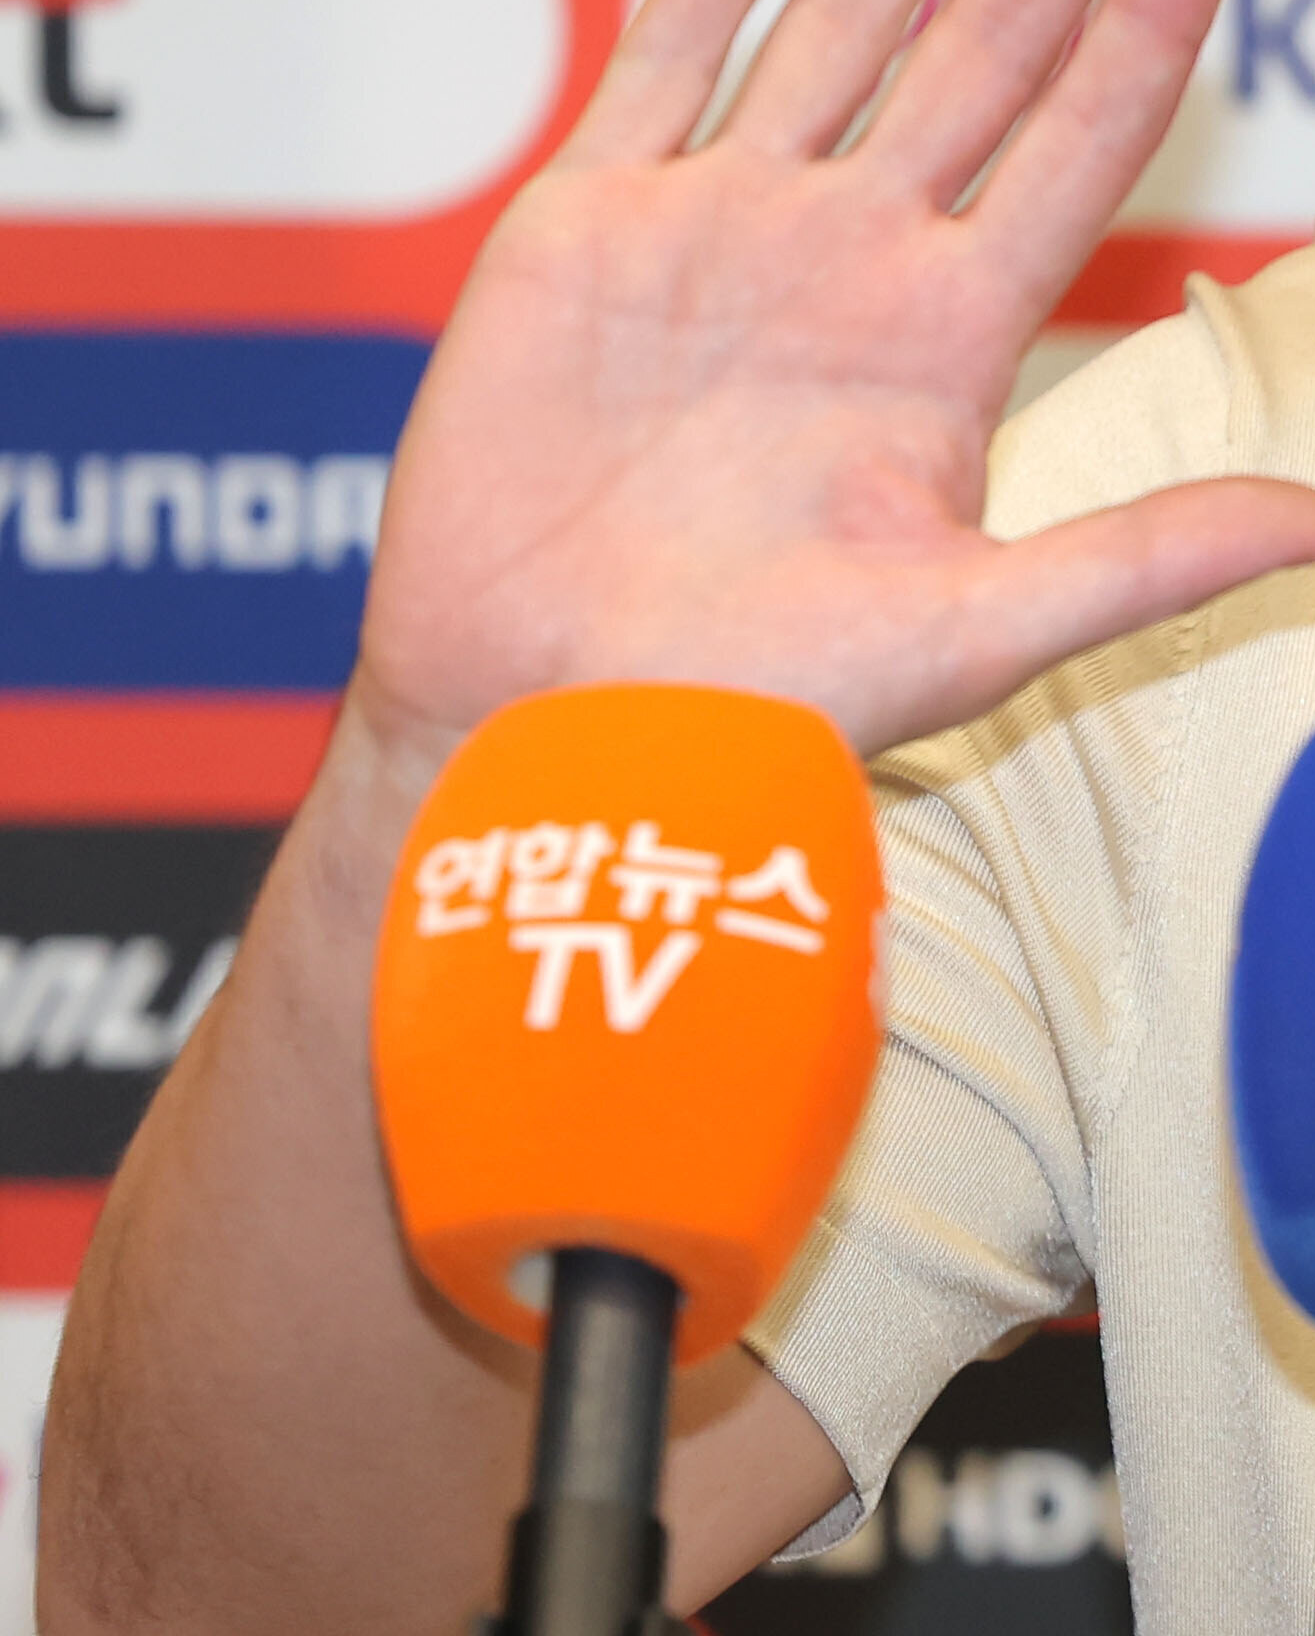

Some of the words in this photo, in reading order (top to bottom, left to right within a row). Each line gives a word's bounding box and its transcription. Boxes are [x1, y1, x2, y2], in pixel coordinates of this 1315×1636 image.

[0, 452, 392, 572] UNDA
[414, 820, 829, 954] 연합뉴스
[508, 921, 702, 1035] TV
[900, 1446, 1126, 1568] HD
